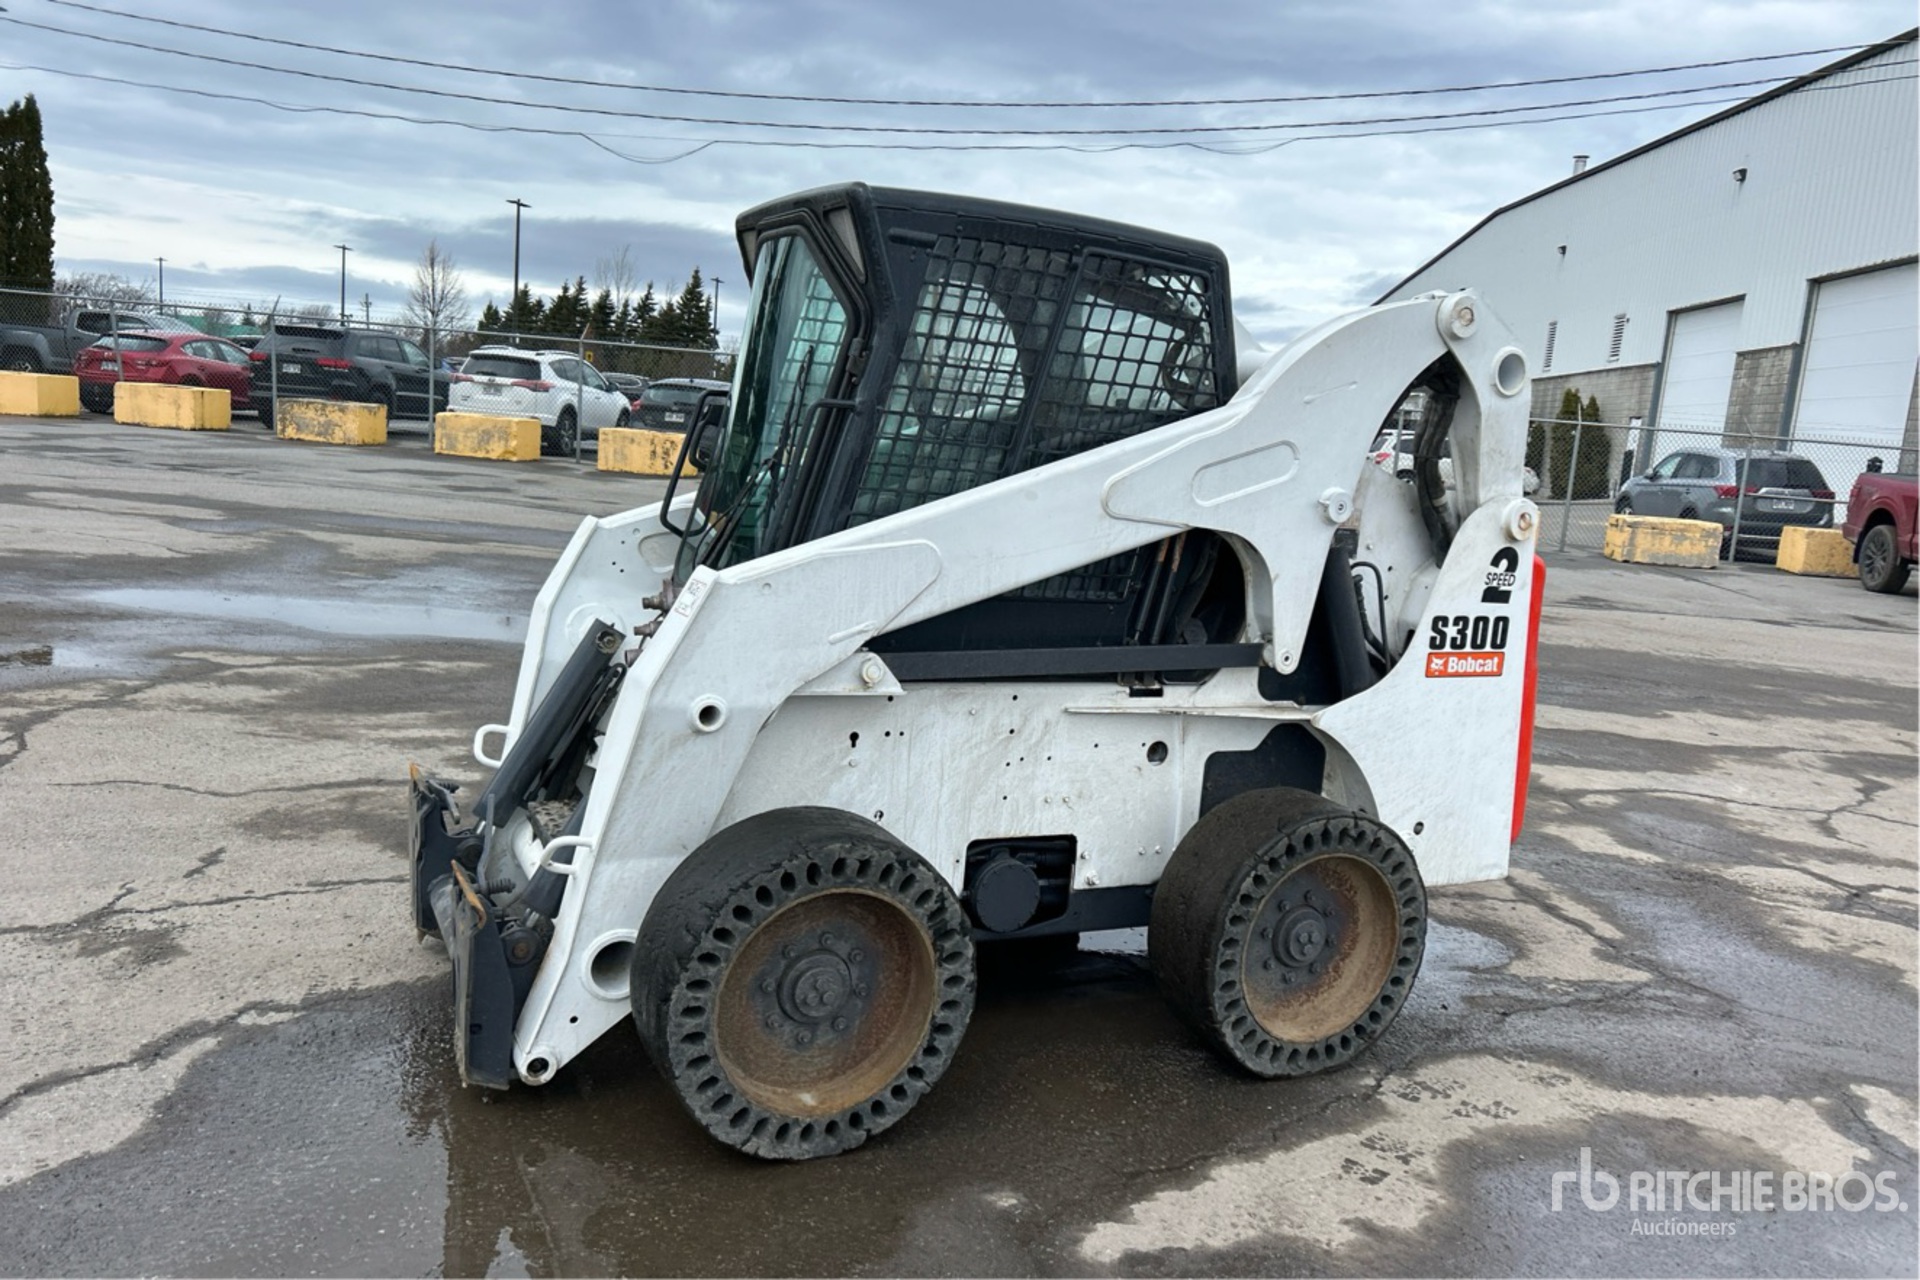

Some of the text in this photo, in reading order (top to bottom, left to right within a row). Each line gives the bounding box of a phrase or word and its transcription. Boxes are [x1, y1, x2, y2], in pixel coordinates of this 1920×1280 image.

[1481, 546, 1519, 604] 2
[1484, 572, 1516, 587] SPEED
[1429, 615, 1510, 650] S300
[1447, 656, 1499, 673] Bobcat
